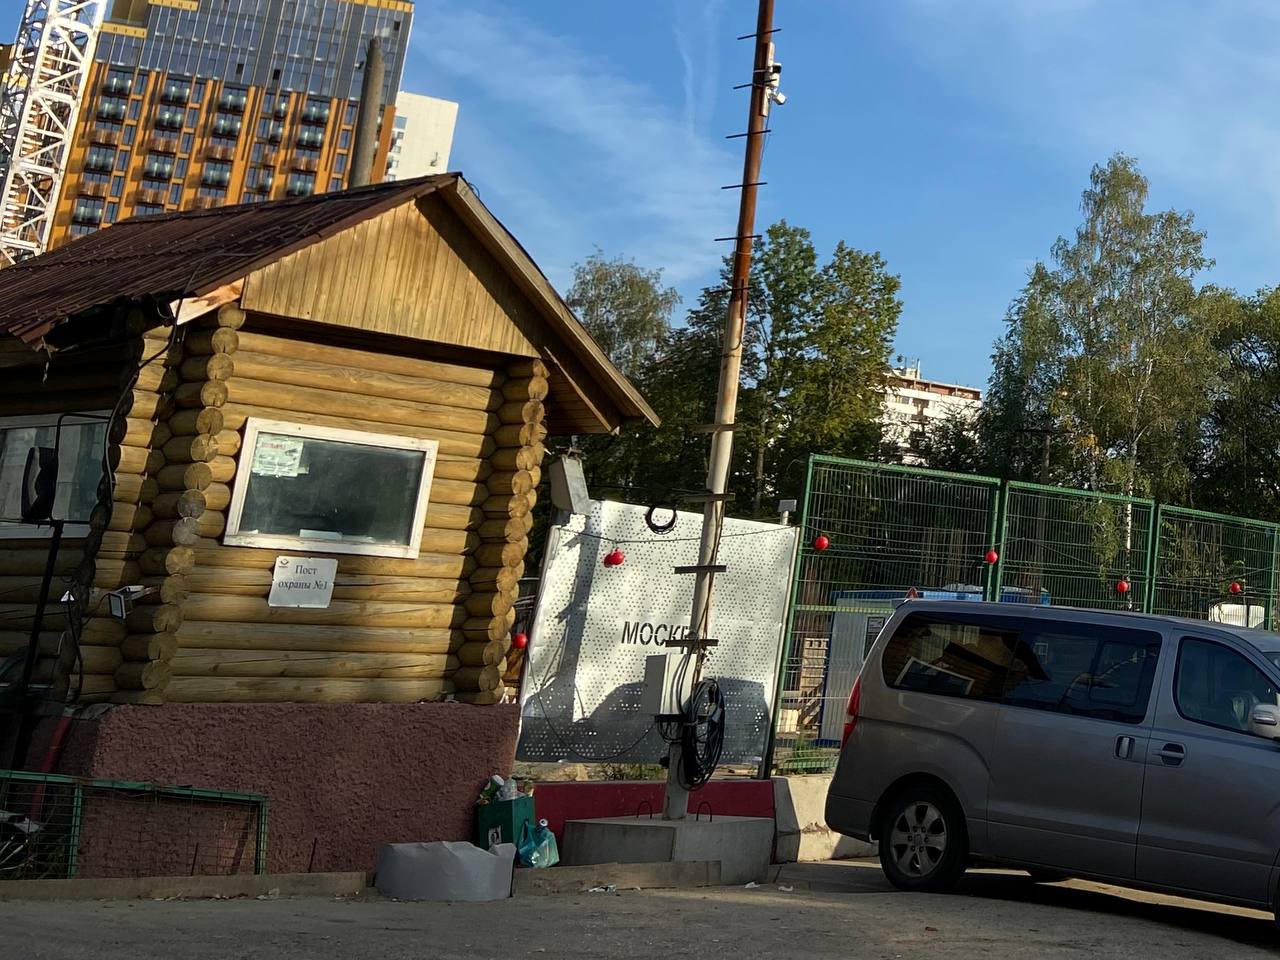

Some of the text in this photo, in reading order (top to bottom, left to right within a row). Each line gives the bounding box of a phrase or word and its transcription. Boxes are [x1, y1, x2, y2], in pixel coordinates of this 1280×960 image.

[295, 564, 318, 575] Пост
[278, 580, 328, 590] охраны №1
